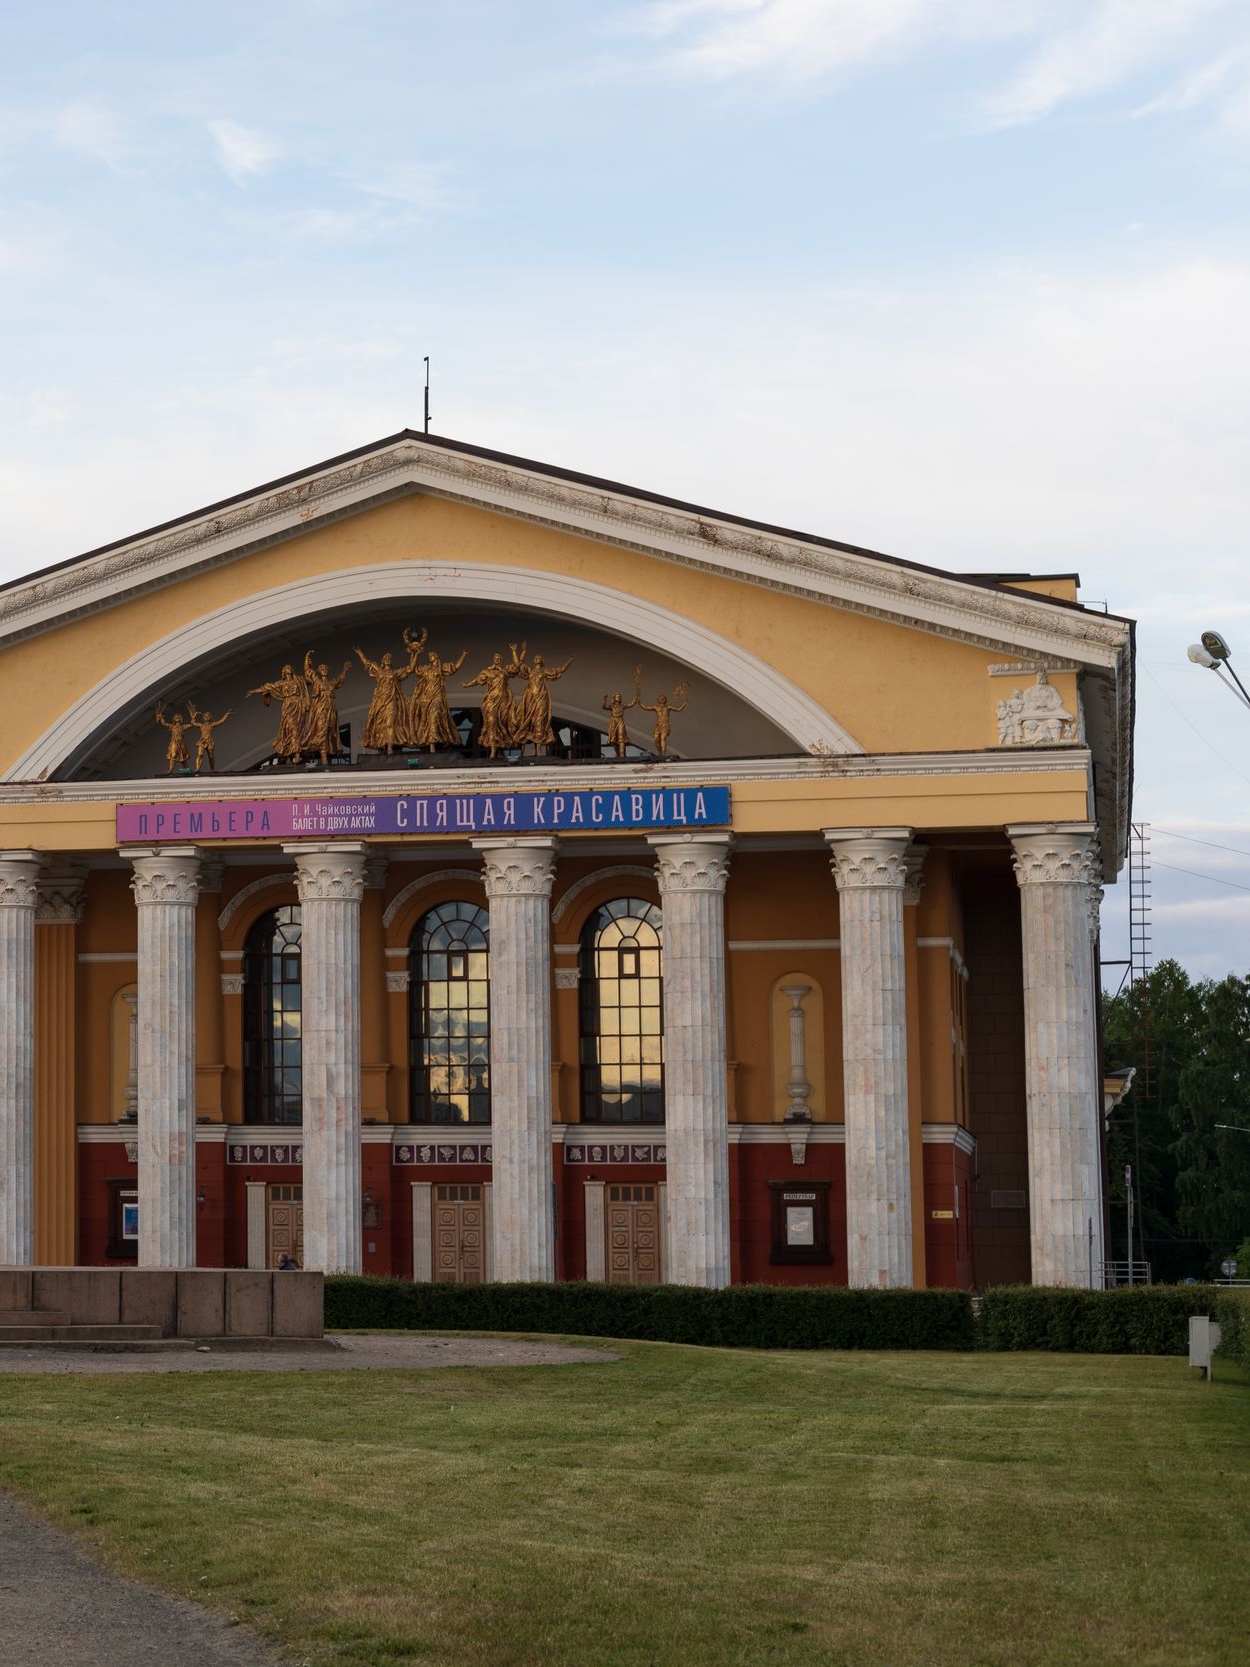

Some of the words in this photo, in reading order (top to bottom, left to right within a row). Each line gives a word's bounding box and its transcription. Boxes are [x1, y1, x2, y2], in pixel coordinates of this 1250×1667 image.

[292, 804, 301, 816] П.
[304, 804, 313, 816] И.
[316, 802, 376, 816] Чайковский
[396, 797, 516, 830] СПЯЩАЯ
[533, 791, 708, 825] КРАСАВИЦА
[138, 810, 271, 835] ПРЕМЬЕРА
[292, 817, 317, 831] БАЛЕТ
[320, 817, 326, 830] В
[327, 816, 349, 831] ДВУХ
[350, 815, 375, 829] АКТАХ
